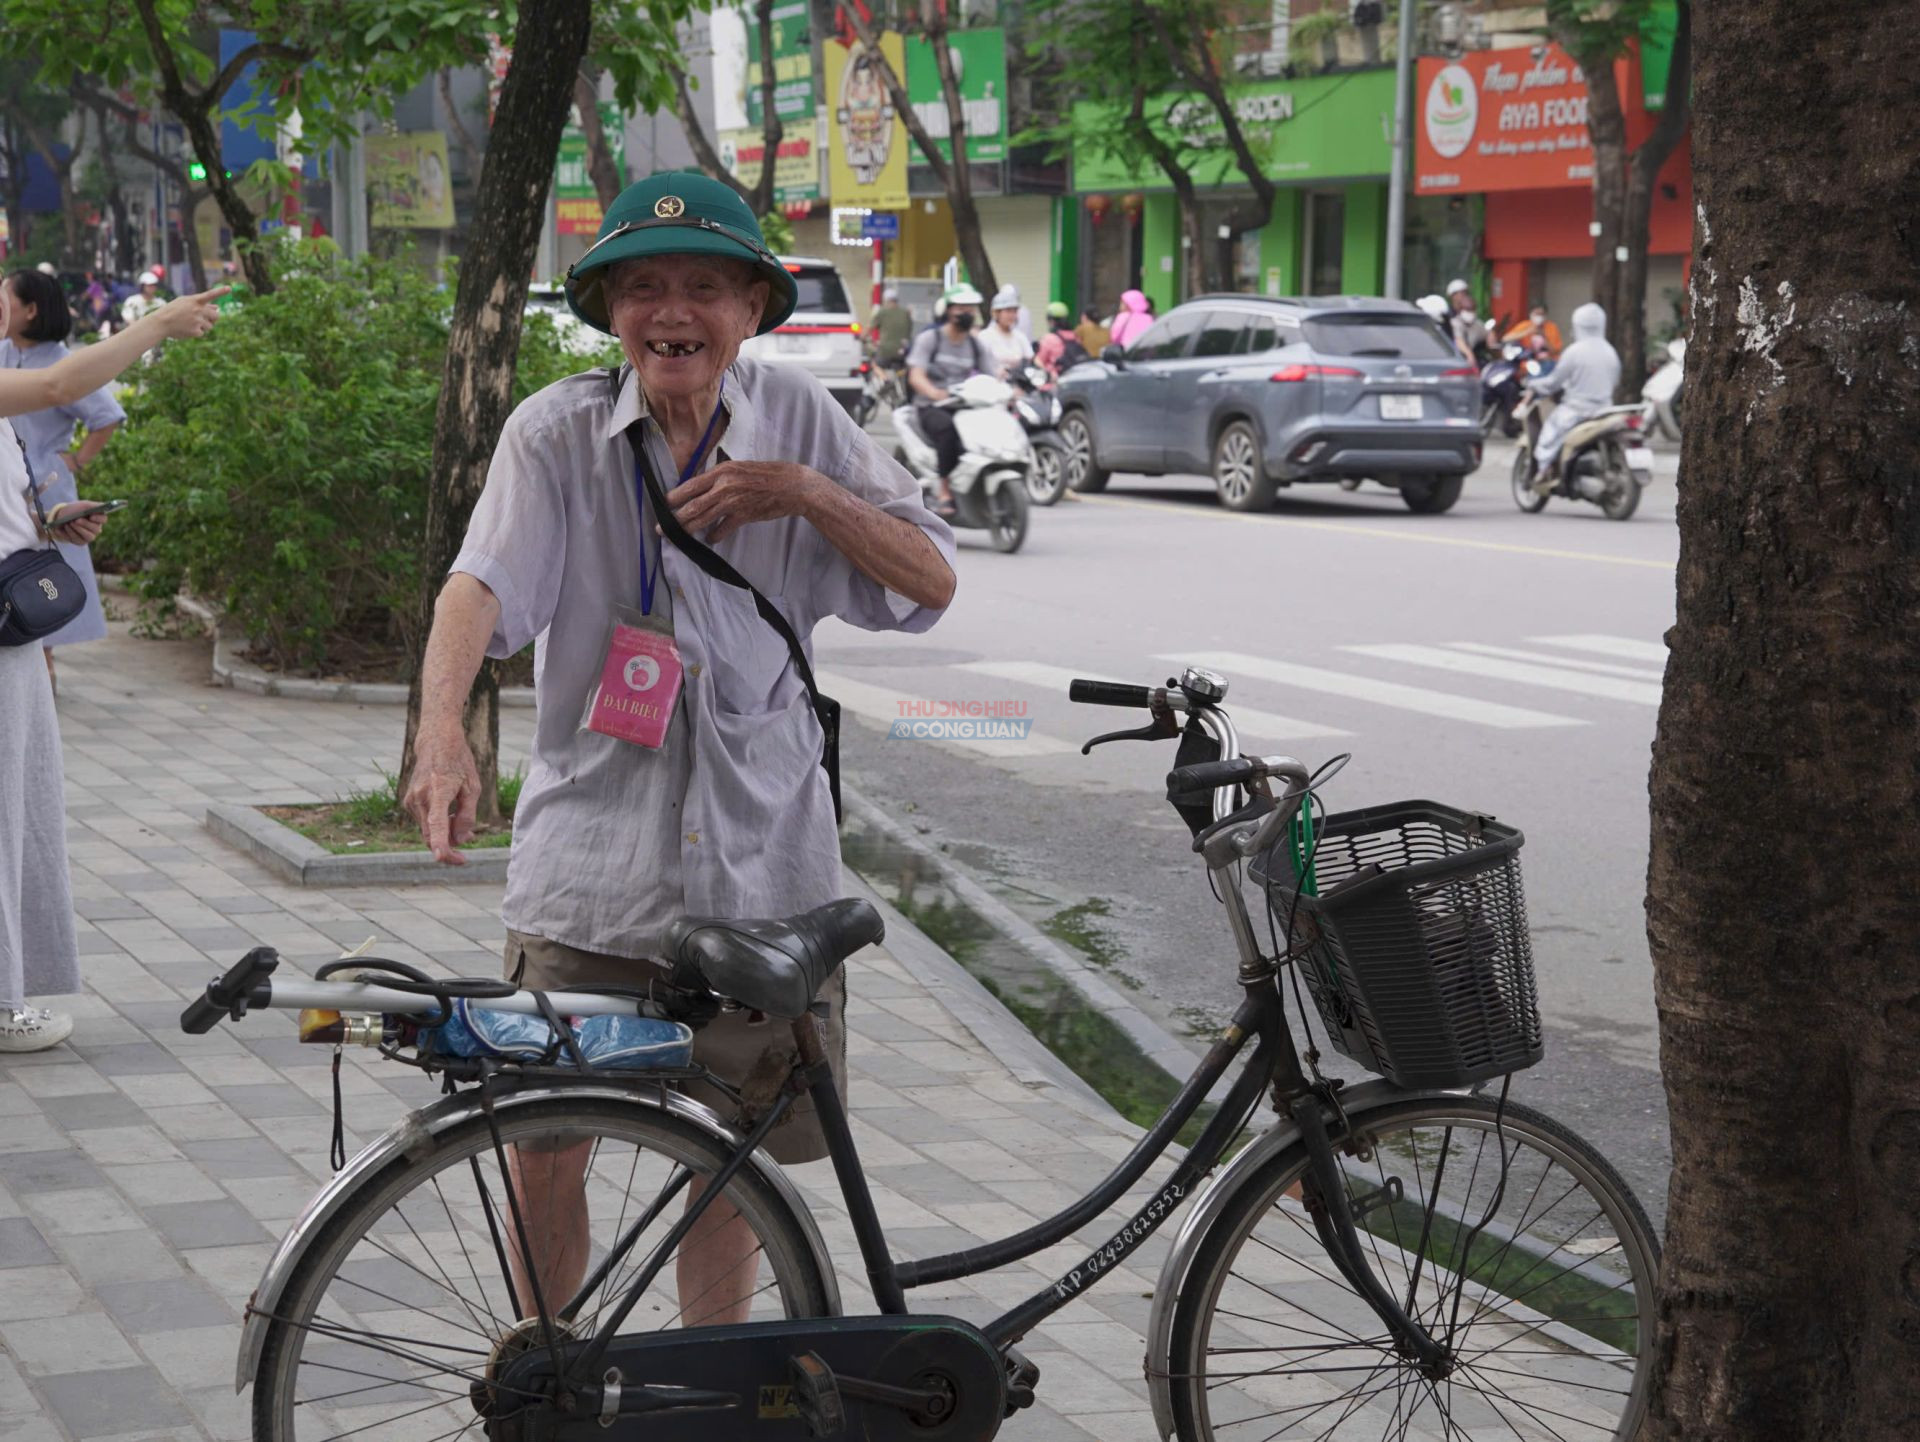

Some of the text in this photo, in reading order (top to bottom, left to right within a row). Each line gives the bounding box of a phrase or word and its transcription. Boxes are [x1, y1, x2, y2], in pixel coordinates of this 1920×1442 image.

[1499, 103, 1540, 131] AYA
[38, 577, 59, 601] B
[1055, 1184, 1185, 1298] KP 02438626752
